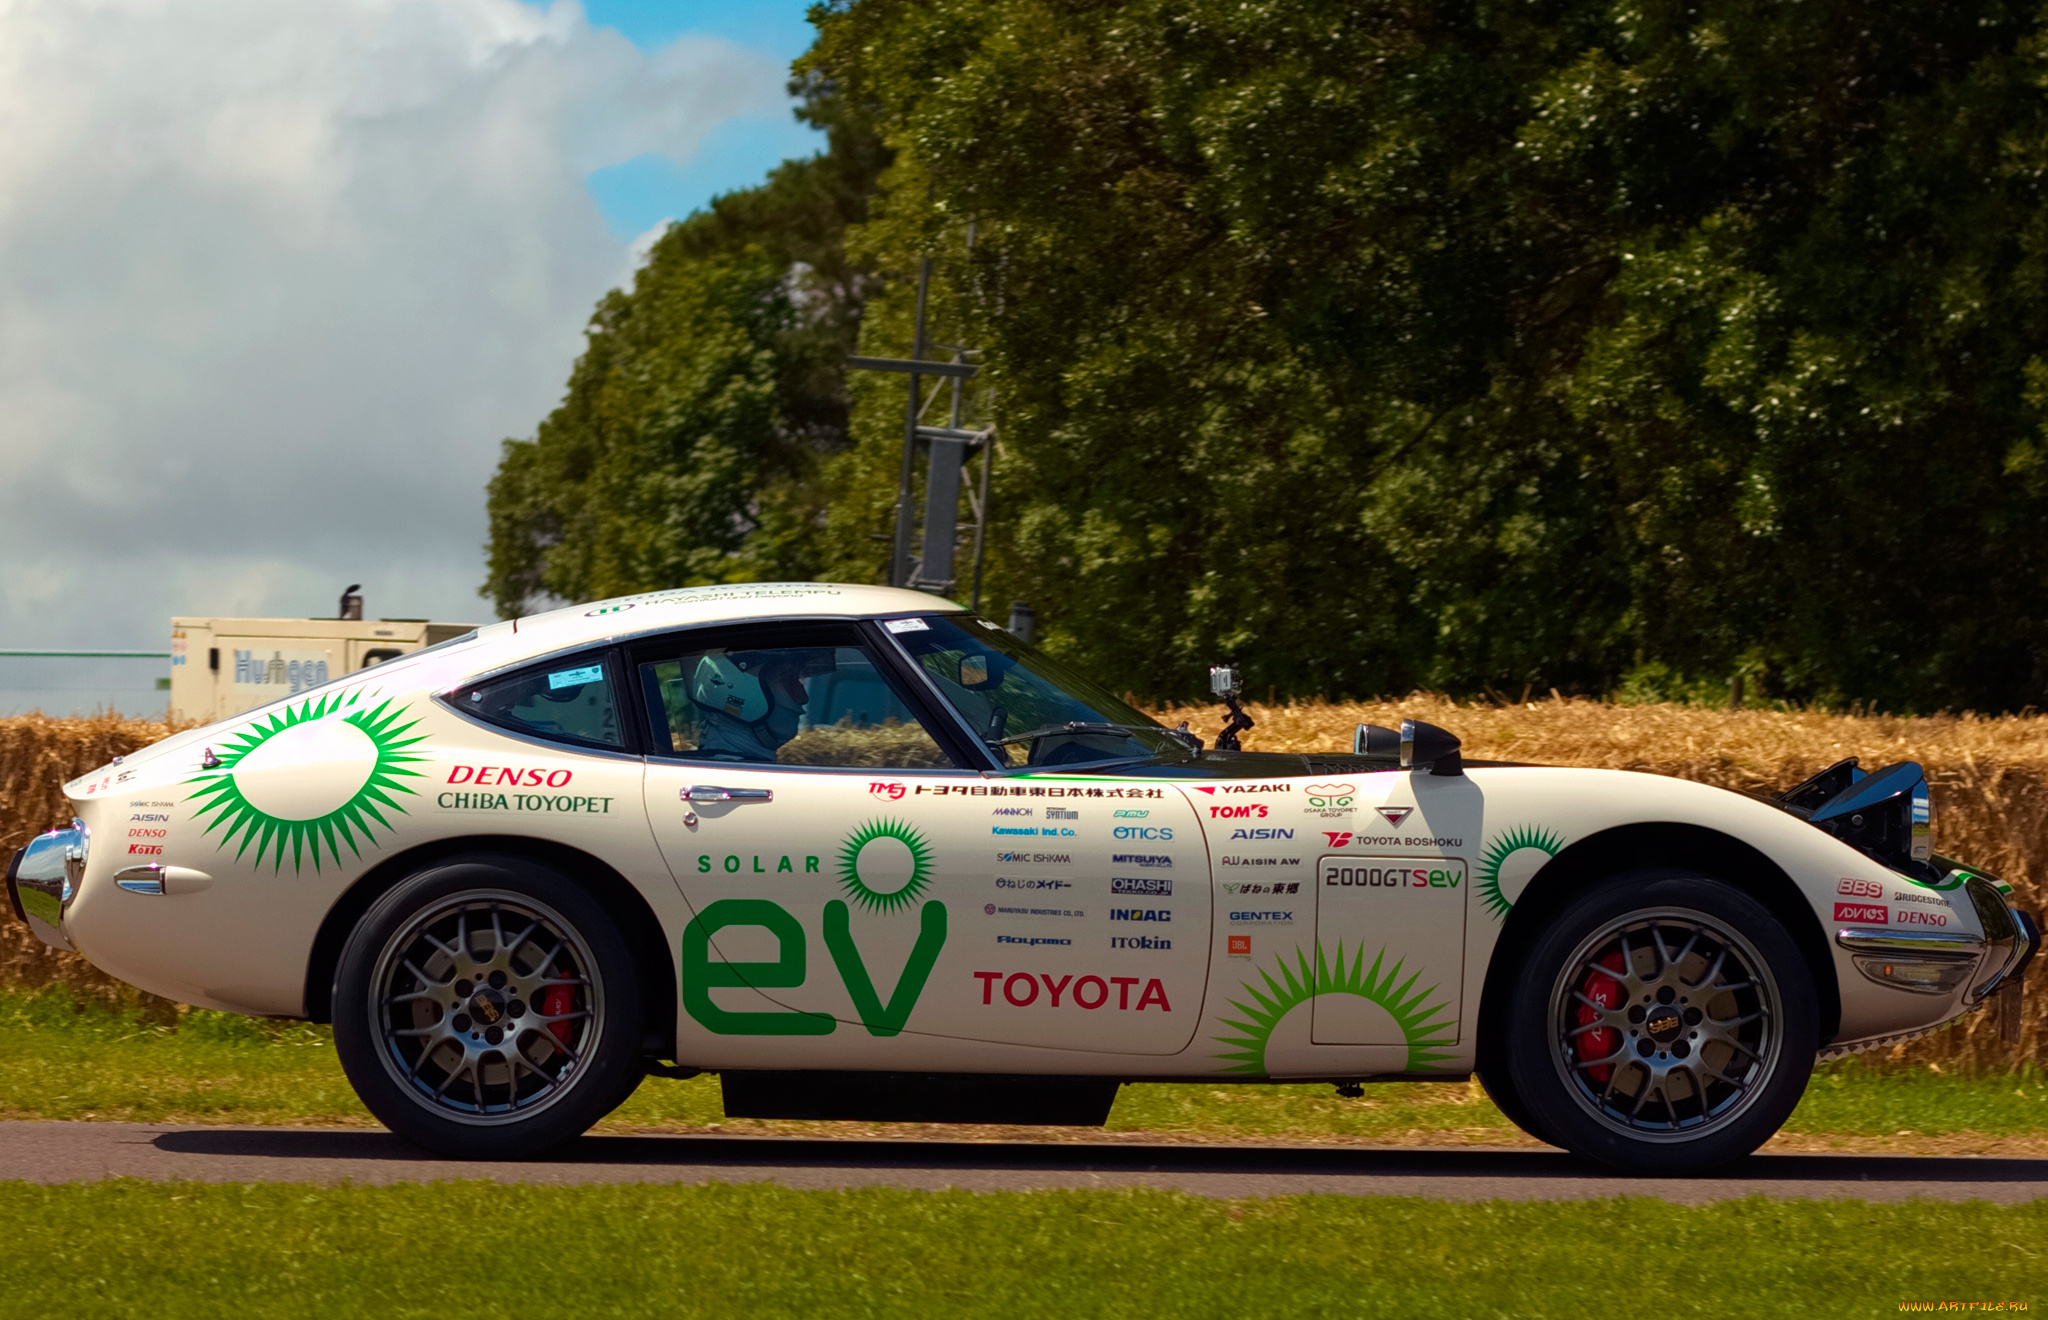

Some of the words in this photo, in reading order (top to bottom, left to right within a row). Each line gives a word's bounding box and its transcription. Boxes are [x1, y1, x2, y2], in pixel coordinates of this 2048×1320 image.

[726, 695, 745, 707] OMP
[447, 765, 573, 788] DENSO
[915, 784, 1165, 799] トヨタ自動車東日本株式会社
[1221, 783, 1291, 794] YAZAKI
[513, 794, 615, 814] TOYOPET
[130, 813, 170, 822] AISIN
[1210, 803, 1269, 819] TOM'S
[128, 828, 167, 838] DENSO
[992, 826, 1039, 836] Kawasaki
[1042, 827, 1060, 837] Ind.
[1061, 827, 1078, 837] Co.
[1113, 826, 1173, 841] OTICS
[1230, 828, 1295, 840] AISIN
[1357, 836, 1402, 847] TOYOTA
[1405, 837, 1463, 848] BOSHOKU
[697, 855, 820, 873] SOLAR
[1112, 854, 1173, 865] MITSUIYA
[1242, 858, 1277, 866] AISIN
[1280, 858, 1301, 866] AW
[1007, 879, 1072, 890] ねじのメイドー
[1113, 879, 1172, 892] OHASHI
[1239, 882, 1300, 895] ばねの東郷
[1837, 877, 1883, 899] BBS
[1894, 891, 1951, 908] BRIDGESTONE
[1030, 908, 1062, 916] INDUSTRIES
[1230, 911, 1293, 921] GENTEX
[1838, 906, 1885, 921] ADVICS
[1897, 911, 1947, 927] DENSO
[1232, 940, 1248, 950] JBL
[682, 898, 948, 1037] ev
[974, 971, 1172, 1012] TOYOTA
